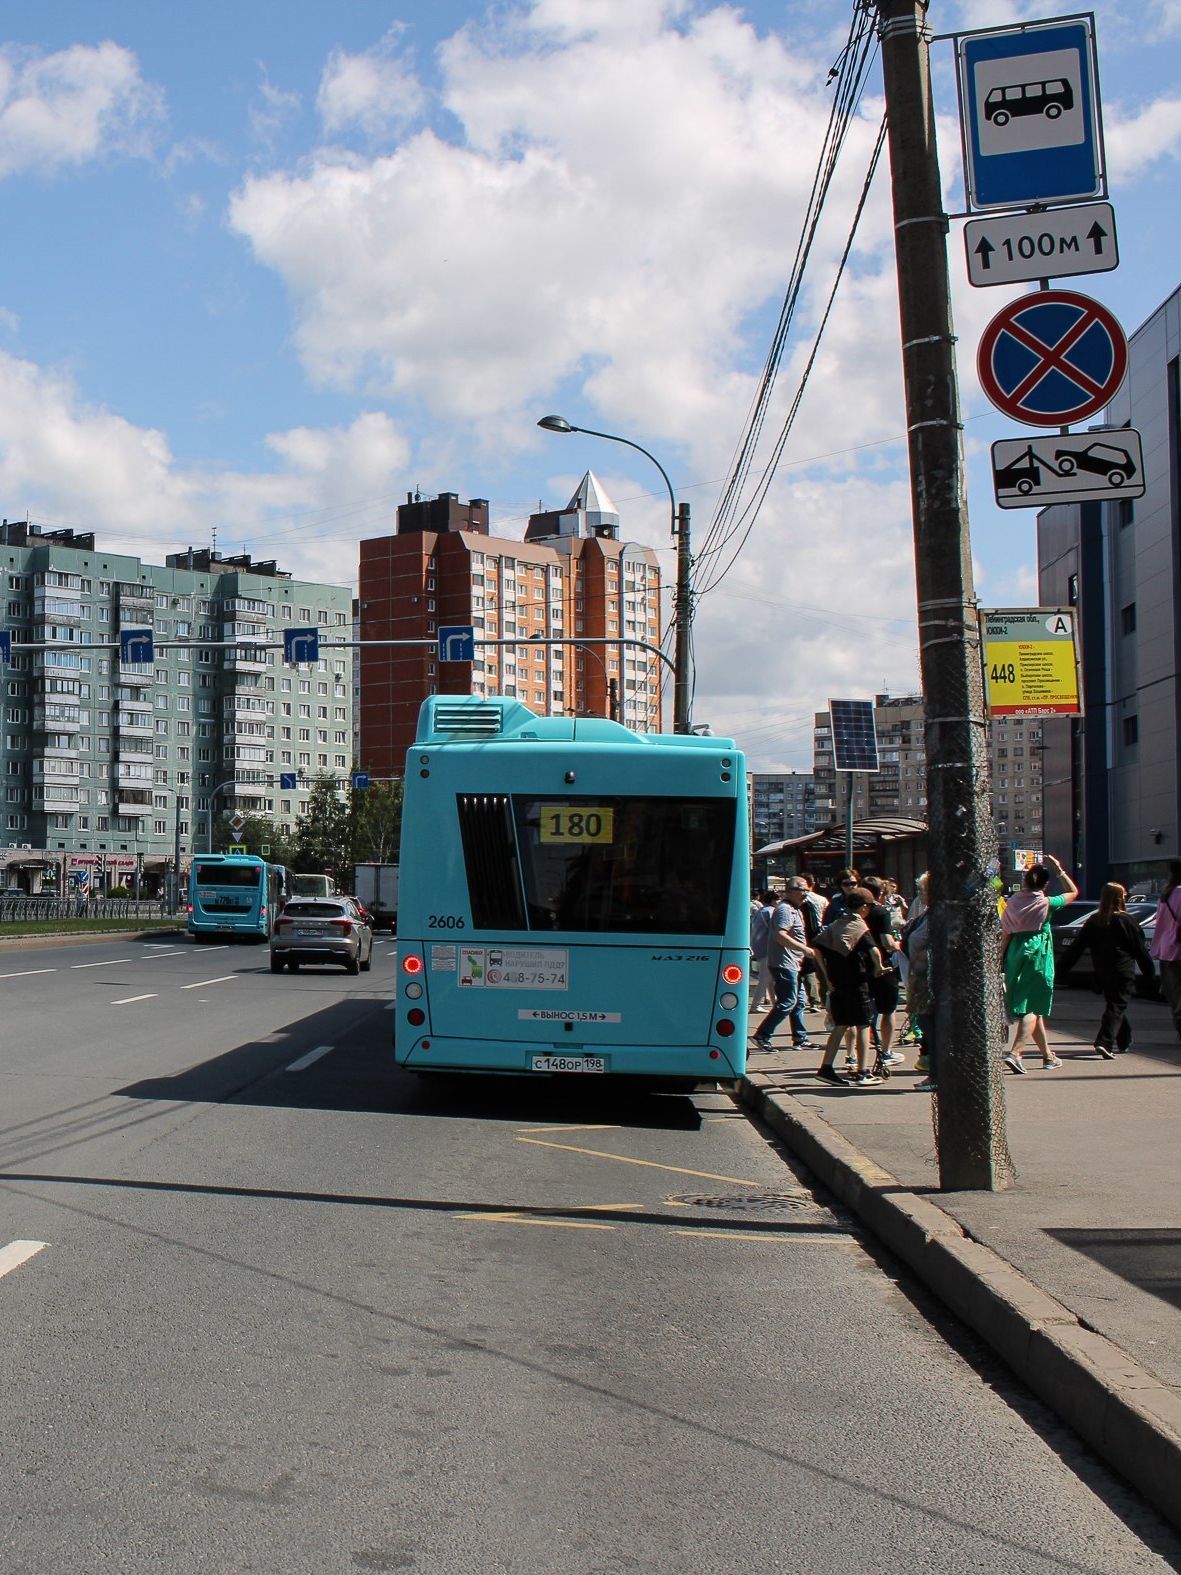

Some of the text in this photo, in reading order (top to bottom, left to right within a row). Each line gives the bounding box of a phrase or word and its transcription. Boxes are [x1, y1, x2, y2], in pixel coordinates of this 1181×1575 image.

[990, 663, 1015, 684] 448
[548, 812, 603, 838] 180
[428, 915, 465, 929] 2606
[505, 960, 565, 969] НАРУШИЛ ПДД?
[503, 971, 565, 984] 48-75-74
[540, 1010, 575, 1020] ВЫНОС
[583, 1058, 603, 1068] 198
